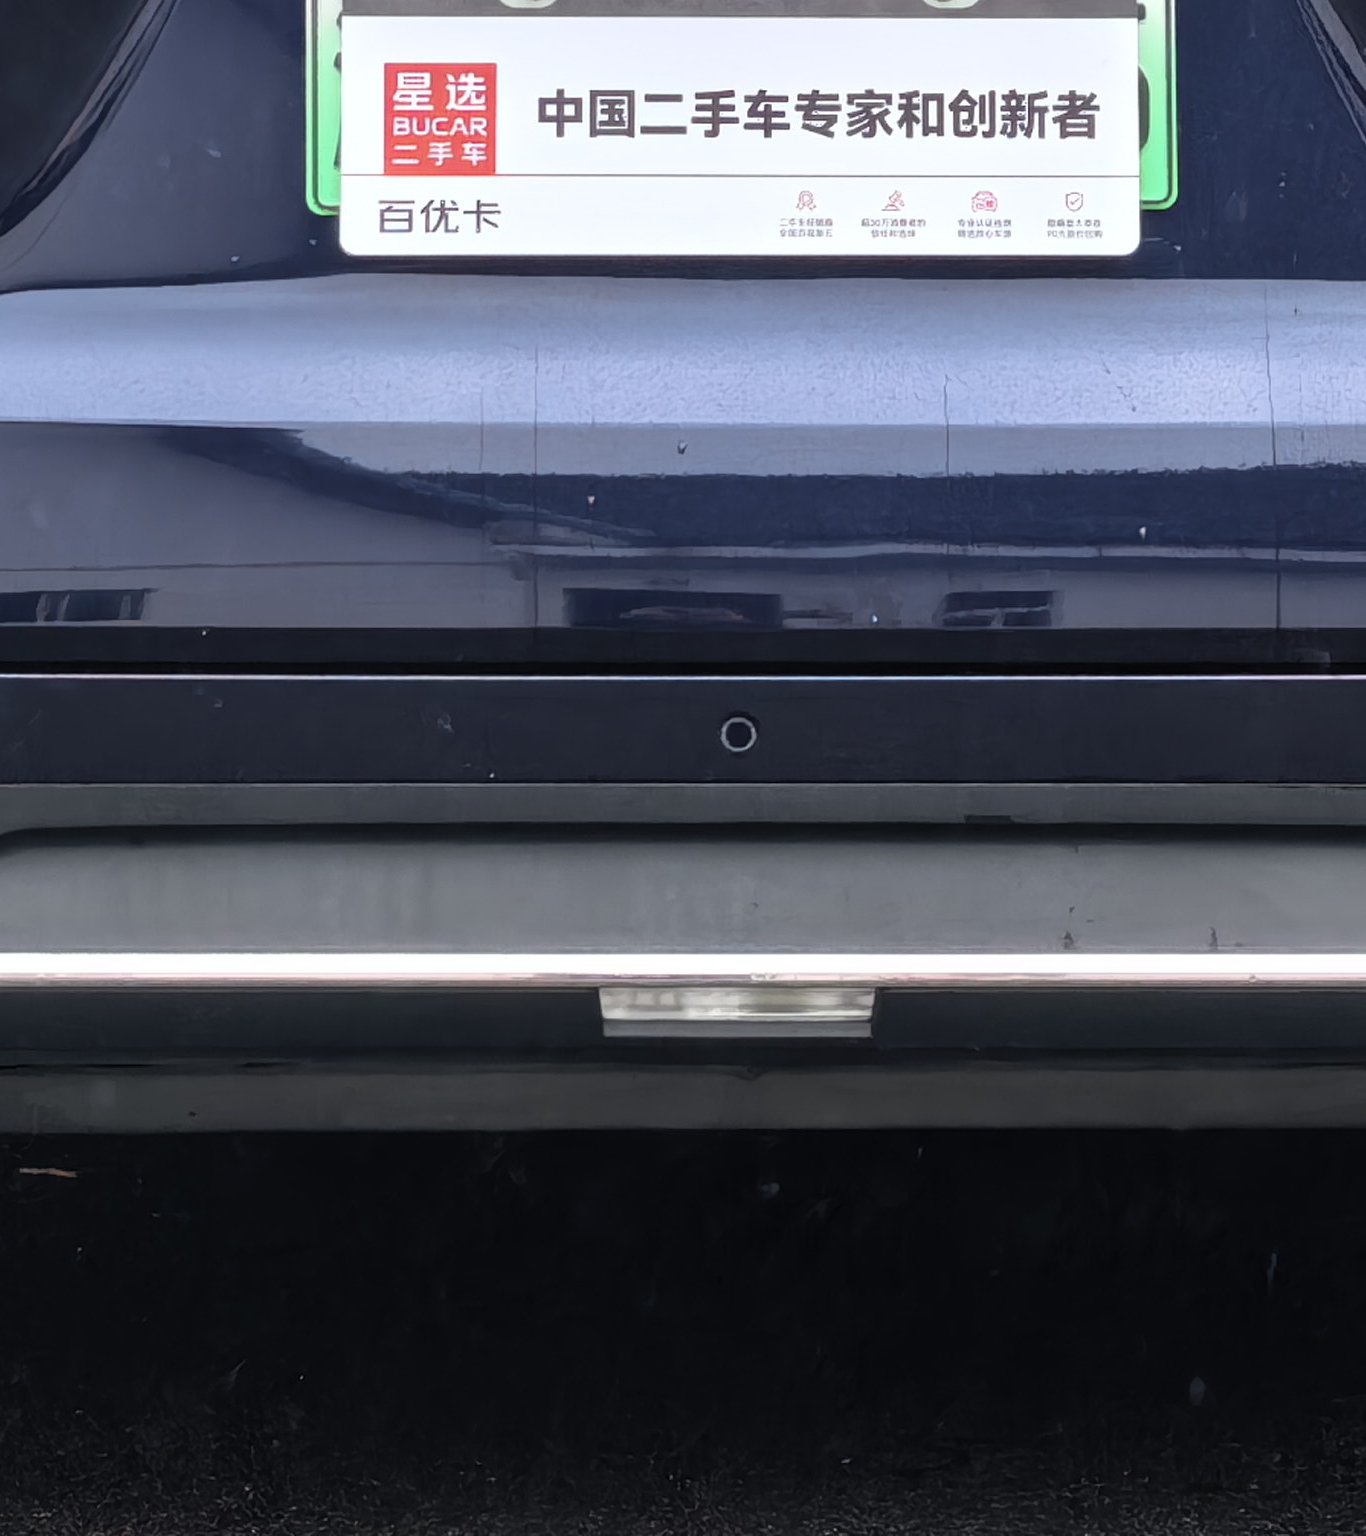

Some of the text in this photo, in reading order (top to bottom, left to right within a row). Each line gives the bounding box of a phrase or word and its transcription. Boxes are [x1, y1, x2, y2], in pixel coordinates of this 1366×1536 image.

[392, 71, 488, 112] 星选
[392, 116, 488, 137] BUCAR
[537, 88, 1102, 140] 中国二手车专家和创新者
[391, 141, 488, 167] 二手车
[378, 199, 502, 234] 百优卡
